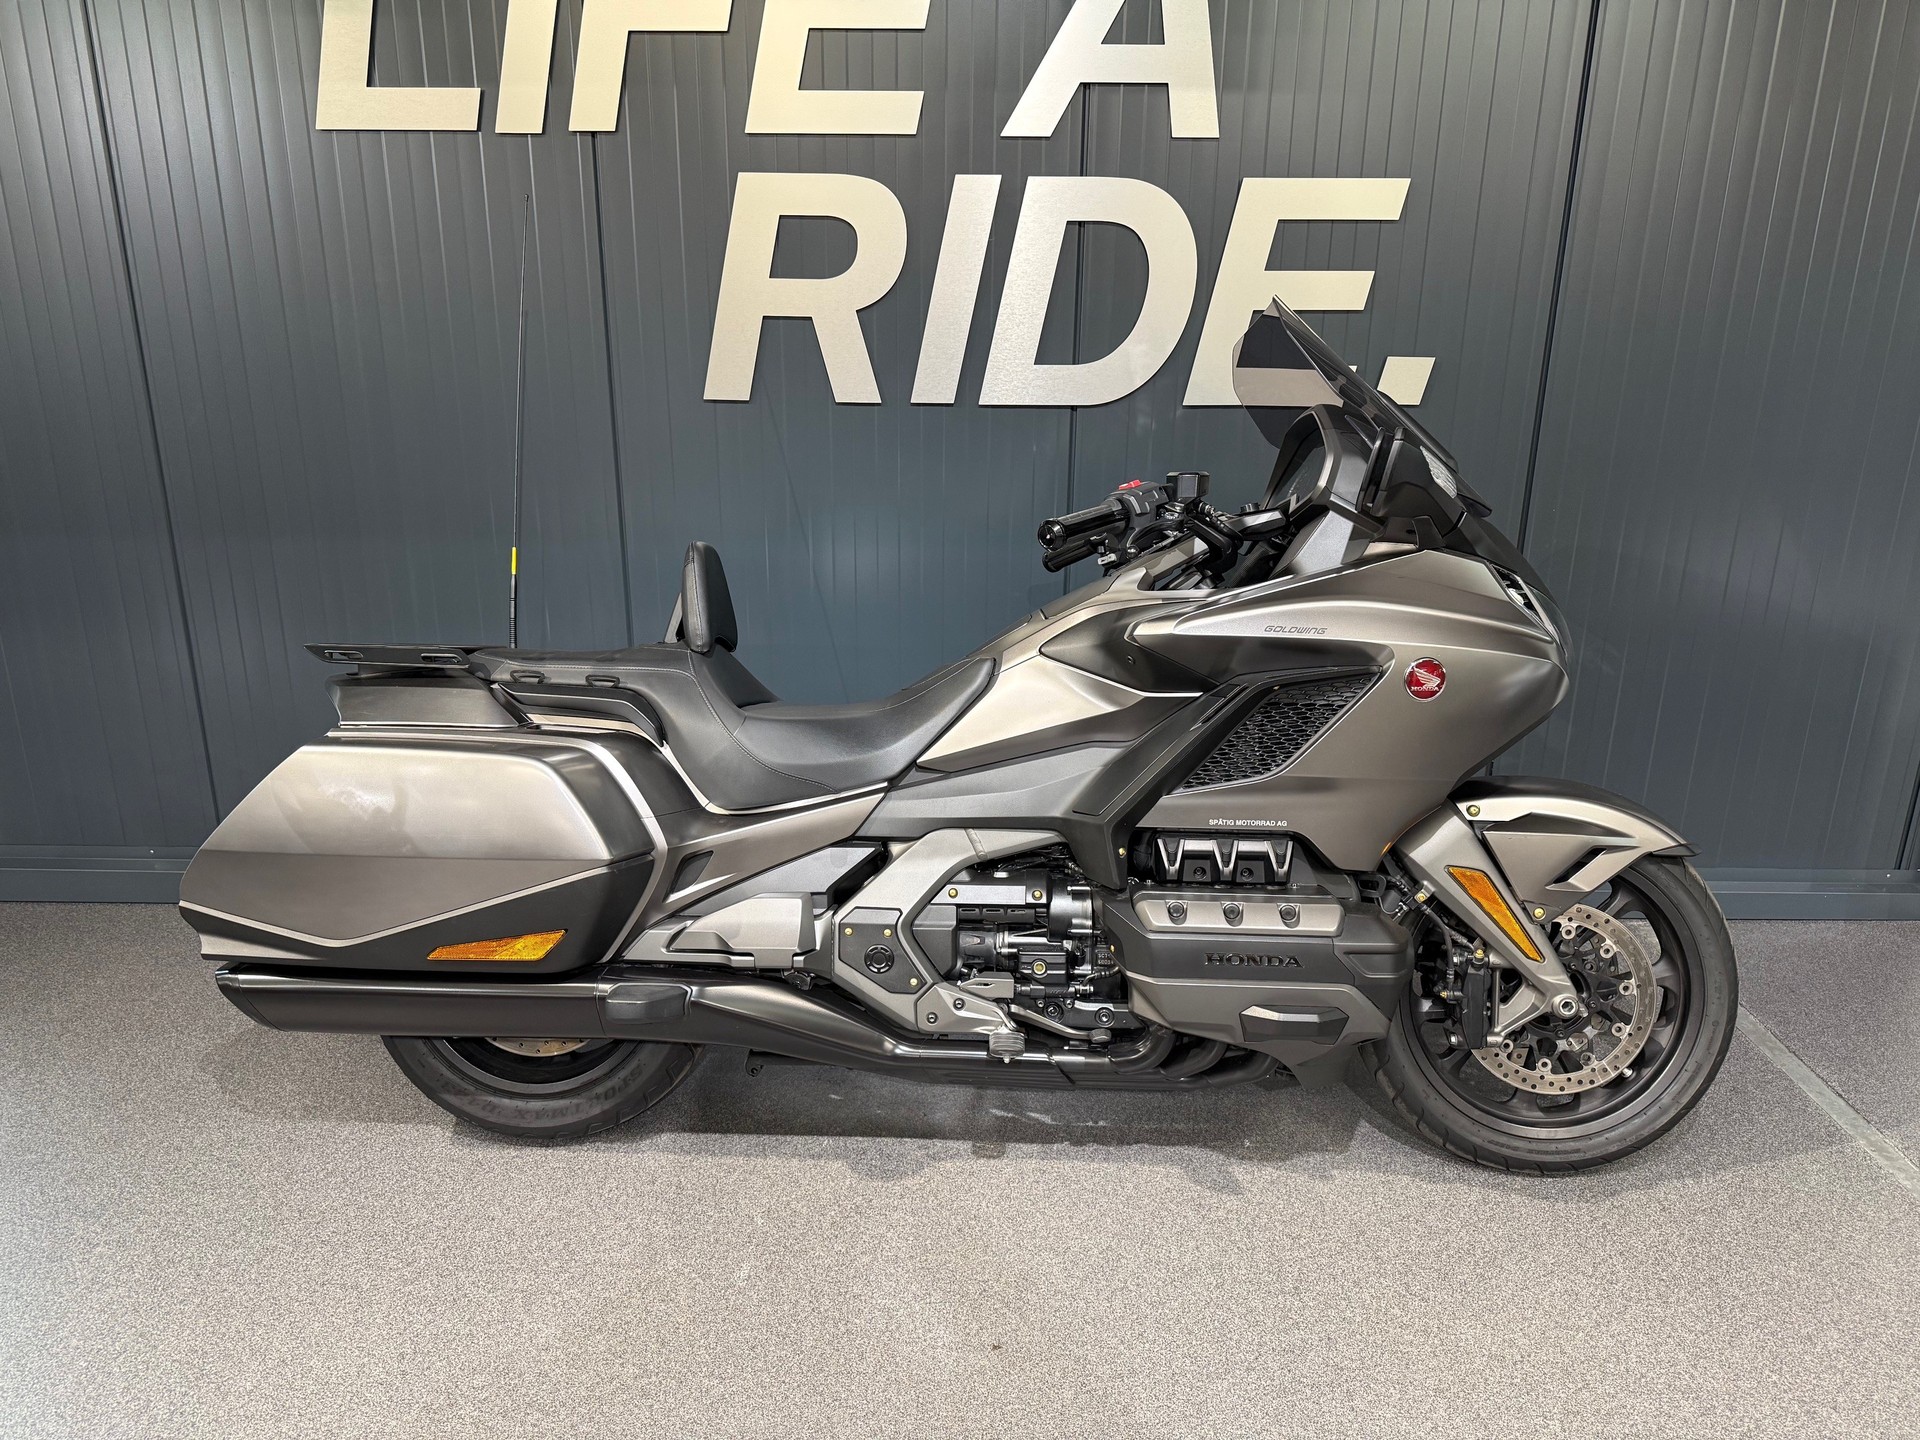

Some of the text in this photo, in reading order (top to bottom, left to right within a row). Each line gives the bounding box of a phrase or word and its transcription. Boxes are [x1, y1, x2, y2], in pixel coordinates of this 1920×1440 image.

[1000, 0, 1221, 139] A
[1264, 625, 1328, 635] GOLDWING
[1208, 818, 1234, 826] SPÄTIG
[1235, 819, 1276, 827] MOTORRAD
[1204, 953, 1304, 968] HONDA
